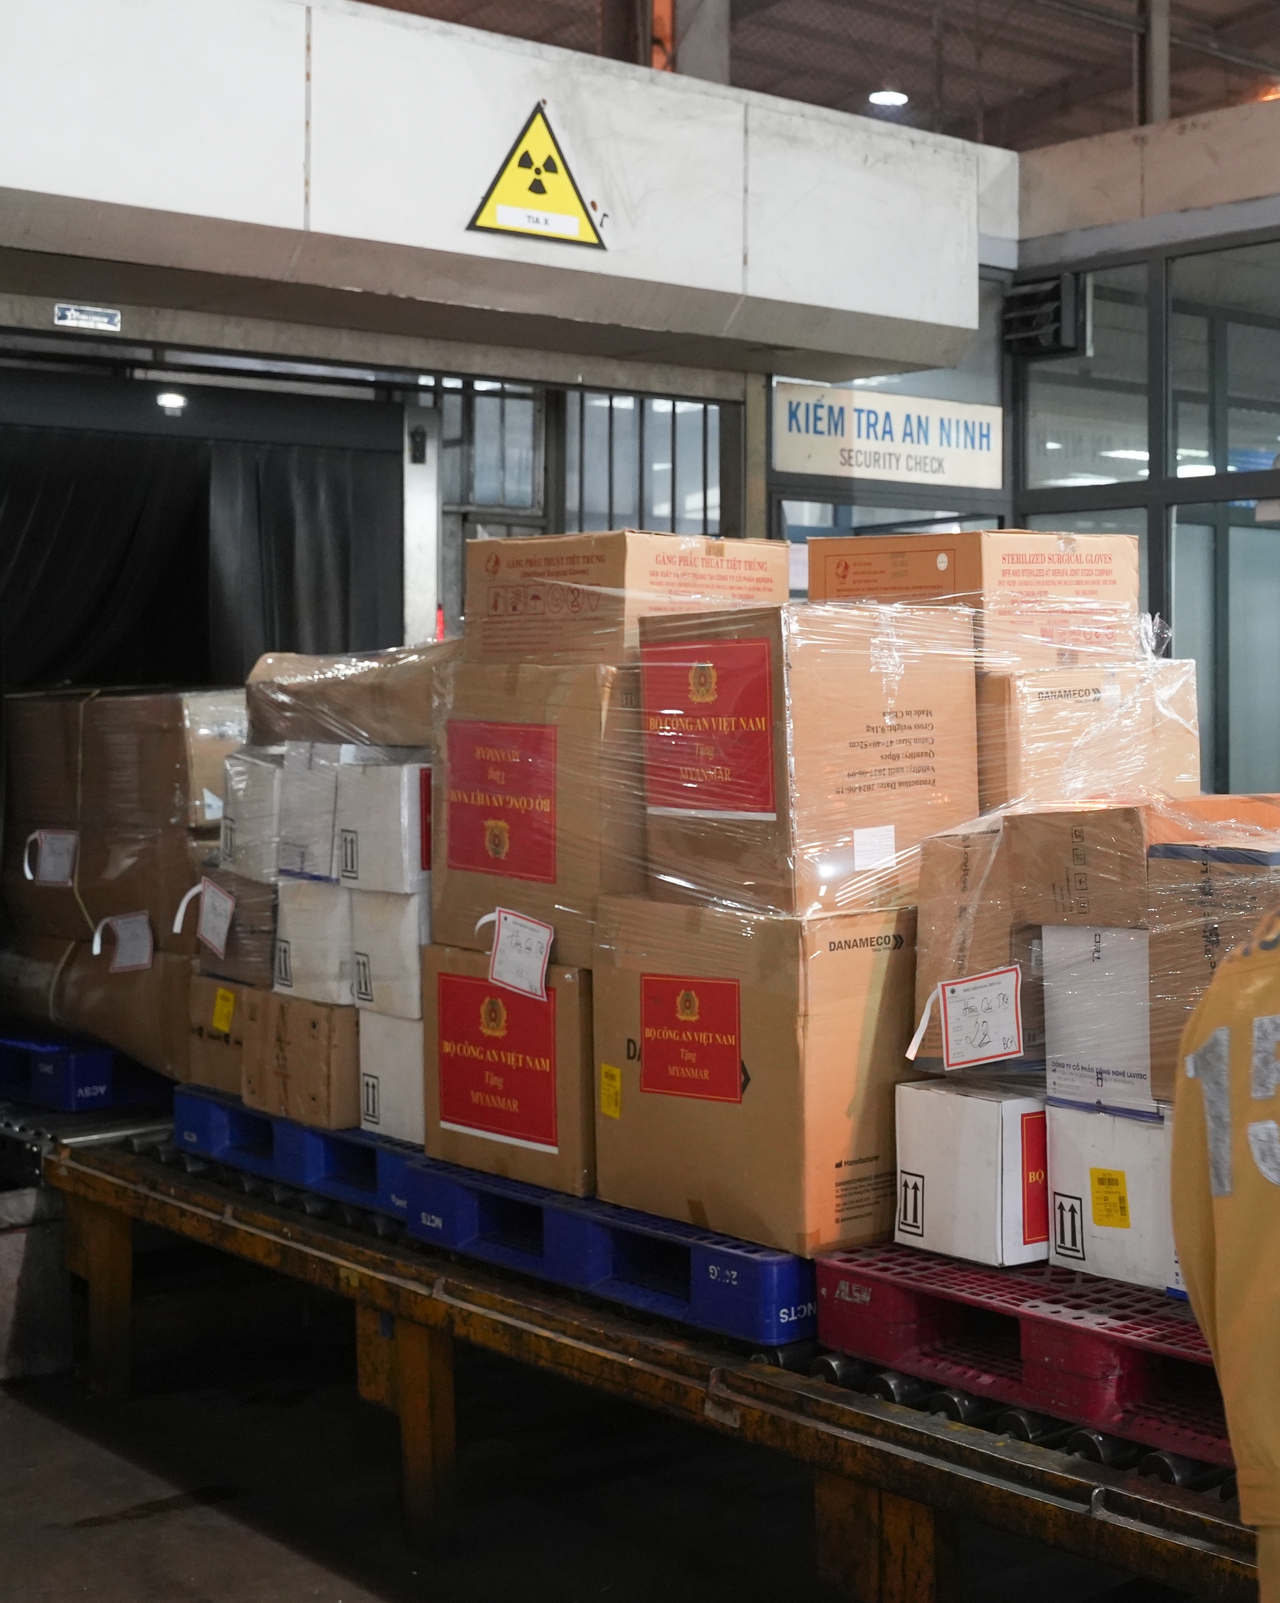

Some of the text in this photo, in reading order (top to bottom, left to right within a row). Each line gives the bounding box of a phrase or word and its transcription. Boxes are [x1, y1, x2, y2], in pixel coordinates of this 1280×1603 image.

[526, 215, 550, 226] TIA X
[788, 394, 991, 451] KIỂM TRA AN NINH
[839, 449, 945, 475] SECURITY CHECK
[1002, 553, 1113, 565] STERILIZED SURGICAL GLOVES
[1038, 688, 1091, 702] DANAMECO
[914, 709, 933, 717] Made
[695, 718, 709, 731] AN
[711, 715, 736, 735] VIỆT
[739, 717, 766, 731] NAM
[913, 723, 934, 731] Gross
[902, 750, 935, 759] Quantity:
[829, 935, 891, 952] DANAMECO
[645, 1026, 736, 1046] BỘ CÔNG AN VIỆT NAM
[456, 1041, 484, 1060] CÔNG
[486, 1049, 499, 1062] AN
[526, 1055, 550, 1072] NAM
[668, 1065, 709, 1080] MYANMAR
[1127, 1072, 1147, 1080] LAVITEC
[1028, 1168, 1044, 1184] BỘ
[779, 1302, 817, 1323] NCTS
